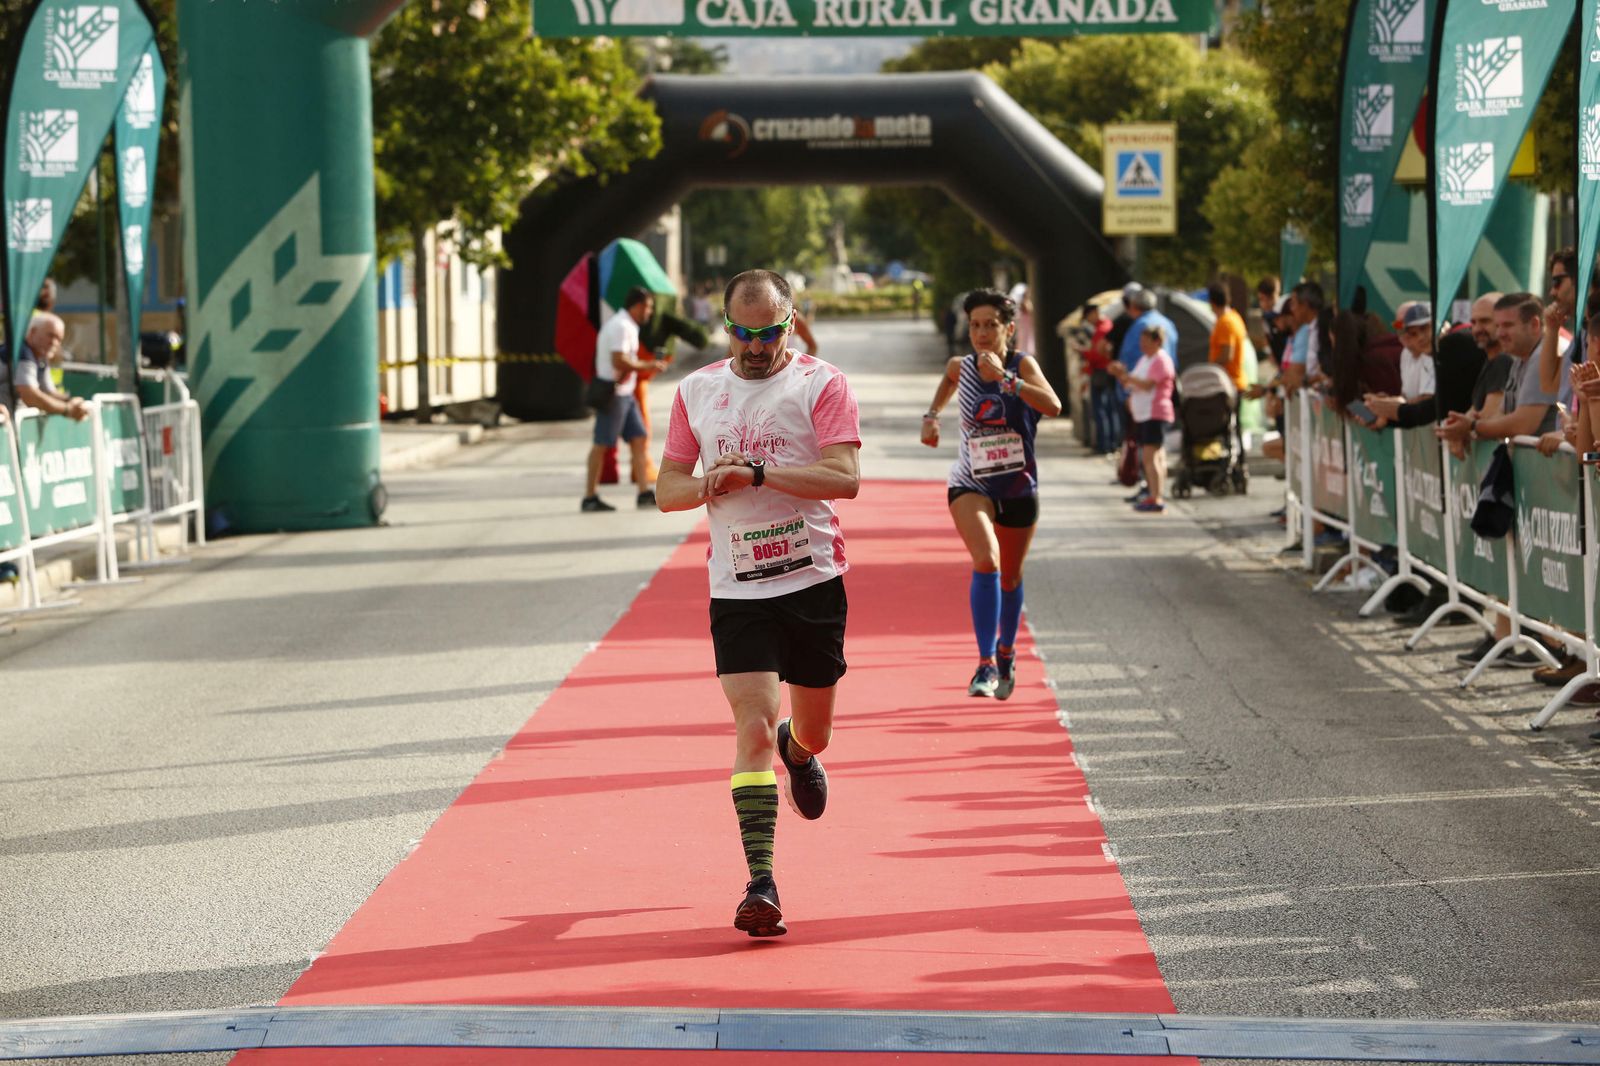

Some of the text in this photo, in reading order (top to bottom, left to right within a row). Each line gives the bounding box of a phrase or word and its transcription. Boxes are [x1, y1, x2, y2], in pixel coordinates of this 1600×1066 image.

[696, 0, 1178, 28] CAJA RURAL GRANADA
[717, 438, 735, 457] Por
[743, 520, 804, 541] COVIRAN
[752, 539, 789, 561] 8057
